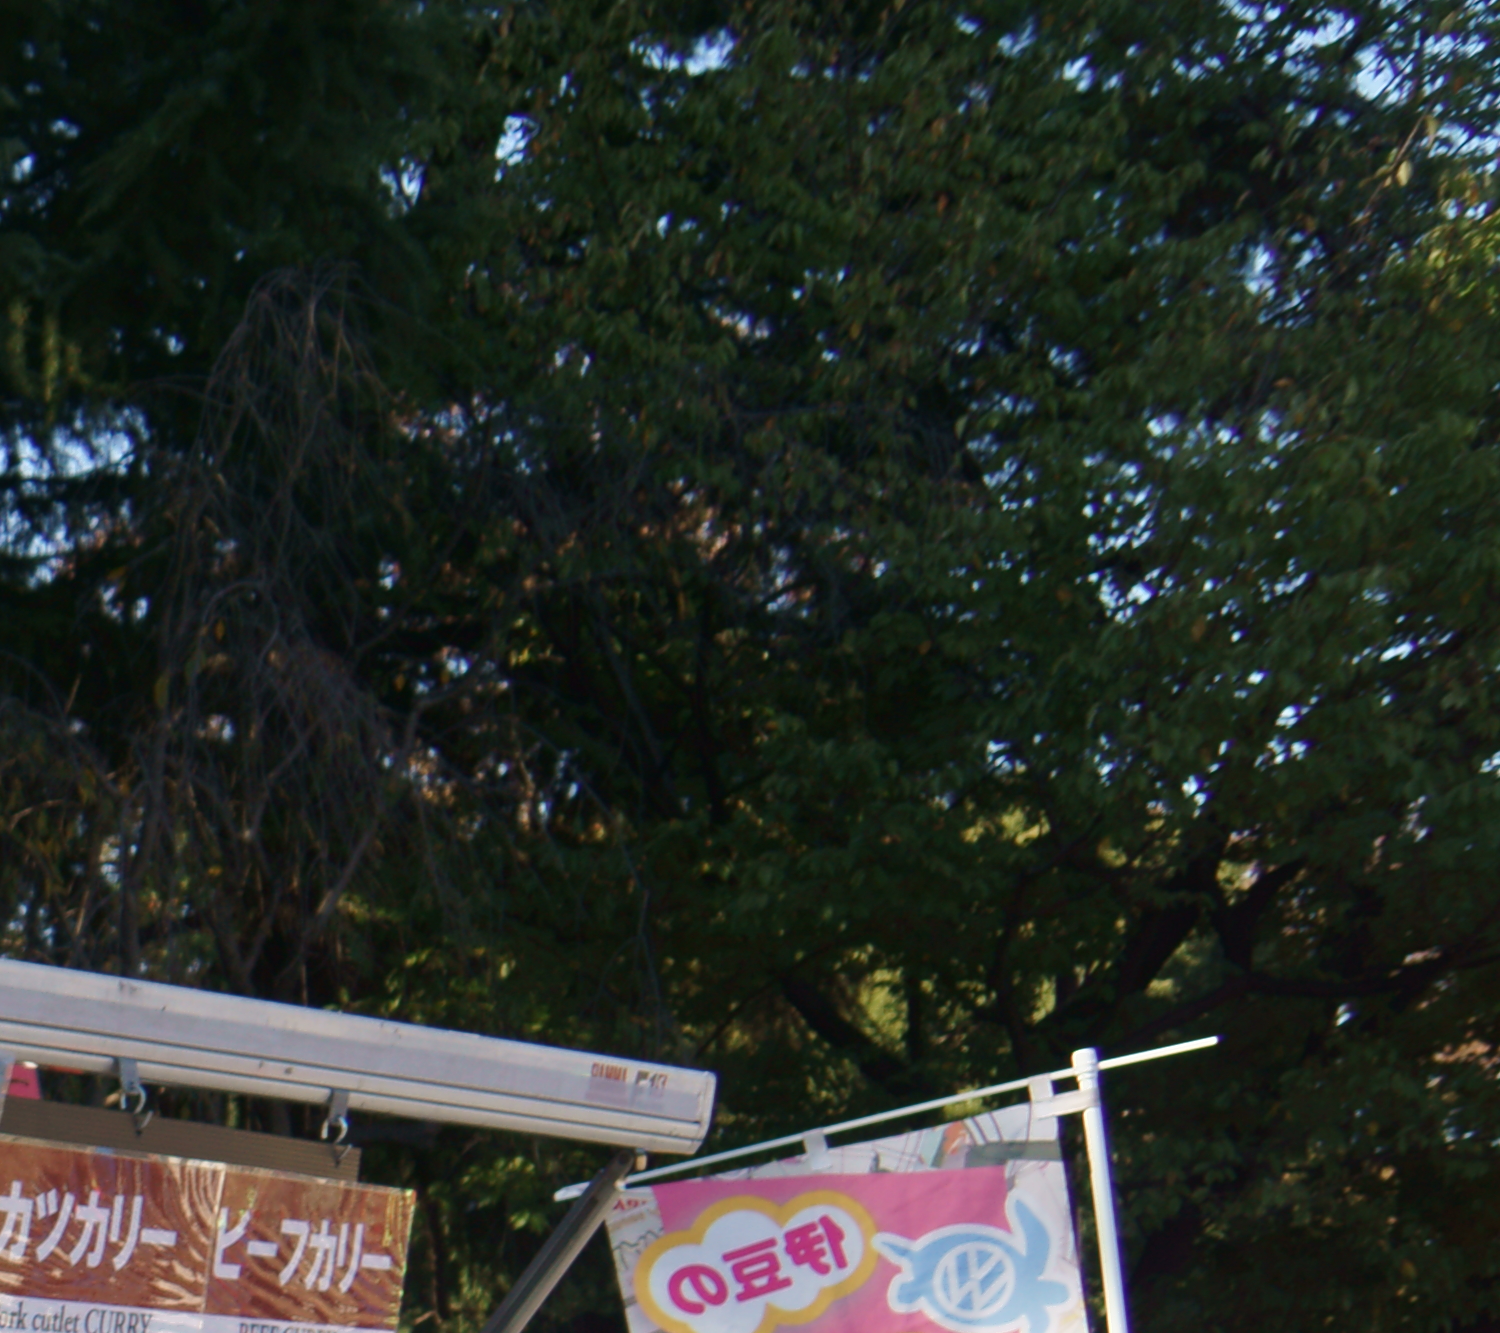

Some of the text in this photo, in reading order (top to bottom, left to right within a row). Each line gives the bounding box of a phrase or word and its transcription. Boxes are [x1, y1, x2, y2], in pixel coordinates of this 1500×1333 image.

[213, 1206, 392, 1294] ビーフカリー
